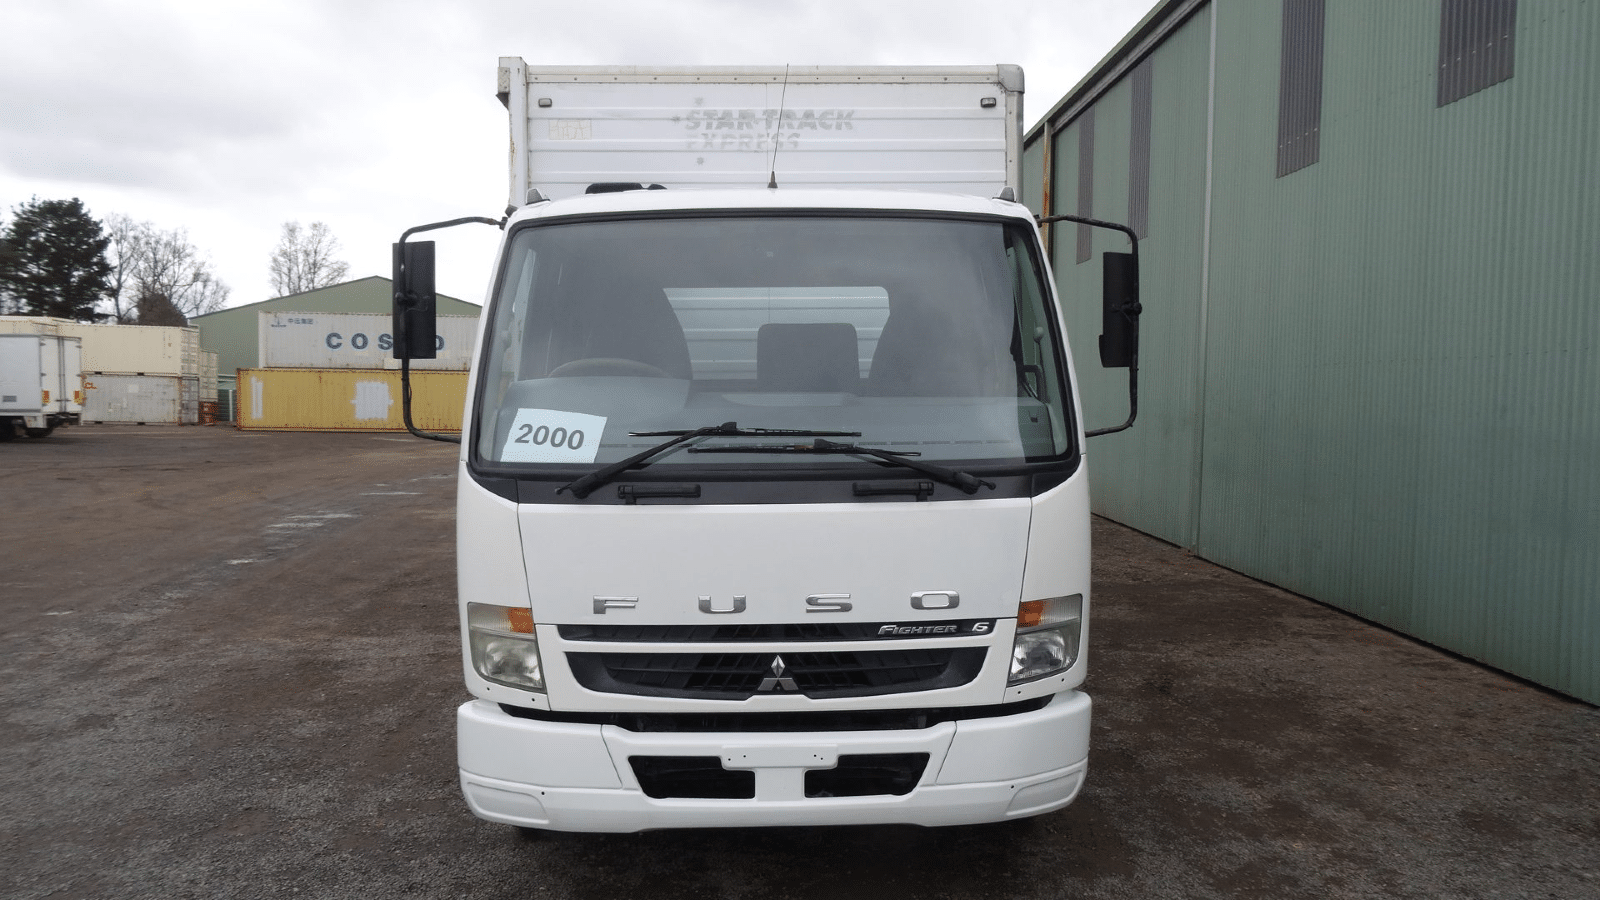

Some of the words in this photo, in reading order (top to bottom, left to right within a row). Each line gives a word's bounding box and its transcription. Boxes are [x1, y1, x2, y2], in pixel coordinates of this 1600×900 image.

[762, 109, 855, 130] TRACK
[514, 423, 585, 450] 2000
[593, 590, 960, 614] FUSO
[878, 624, 957, 635] FIGHTER
[972, 621, 990, 632] 6
